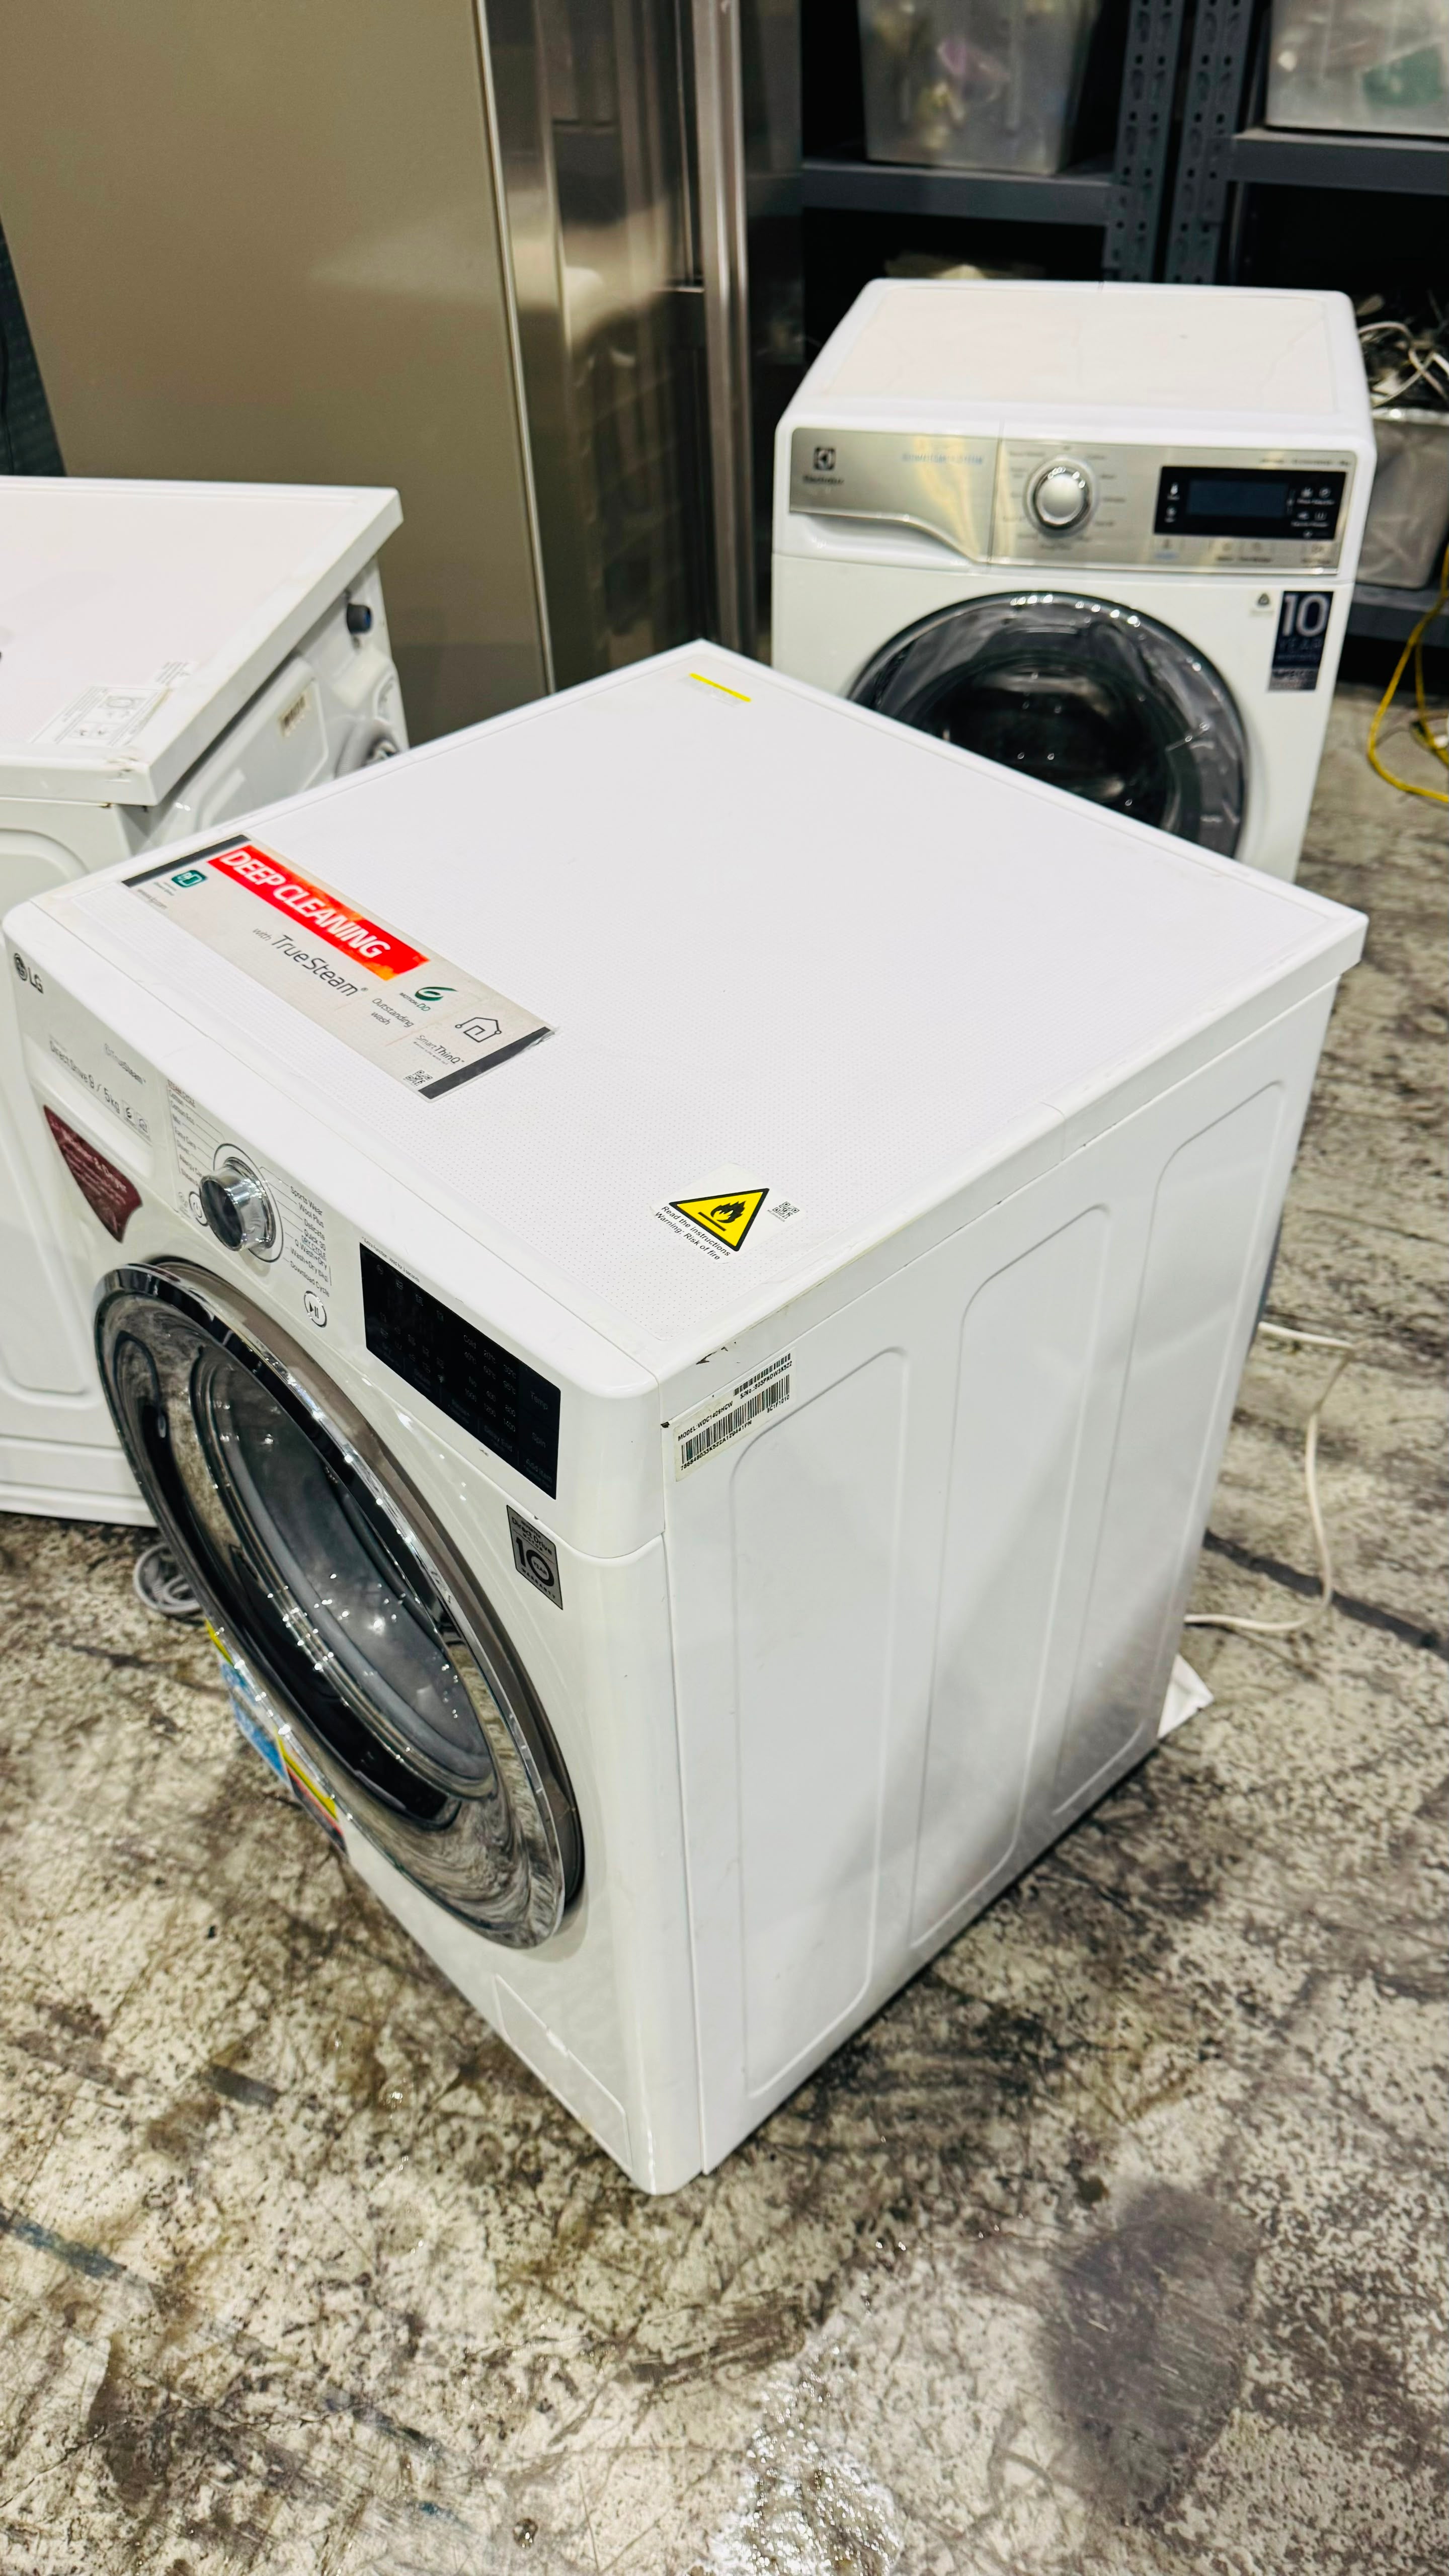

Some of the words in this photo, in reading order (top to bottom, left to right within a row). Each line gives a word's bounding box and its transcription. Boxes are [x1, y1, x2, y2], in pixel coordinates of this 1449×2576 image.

[1283, 593, 1329, 638] 10
[220, 850, 286, 886] DEEP
[273, 884, 391, 958] CLEANING
[252, 928, 272, 941] with
[28, 967, 44, 994] LG
[371, 1011, 391, 1025] wash
[372, 998, 415, 1028] Outstanding
[290, 1186, 308, 1205] Sports
[298, 1202, 312, 1219] Wool
[312, 1213, 325, 1228] Plus
[304, 1218, 326, 1241] Delicate
[304, 1229, 319, 1244] Quick
[661, 1205, 680, 1220] Read
[679, 1219, 691, 1228] the
[690, 1226, 731, 1256] instructions
[683, 1233, 700, 1246] Risk
[707, 1250, 720, 1260] fire
[290, 1260, 315, 1285] Download
[315, 1280, 330, 1298] Cycle
[530, 1390, 548, 1411] Temp
[512, 1516, 533, 1540] Direct
[534, 1536, 552, 1556] Drive
[515, 1537, 555, 1587] 10
